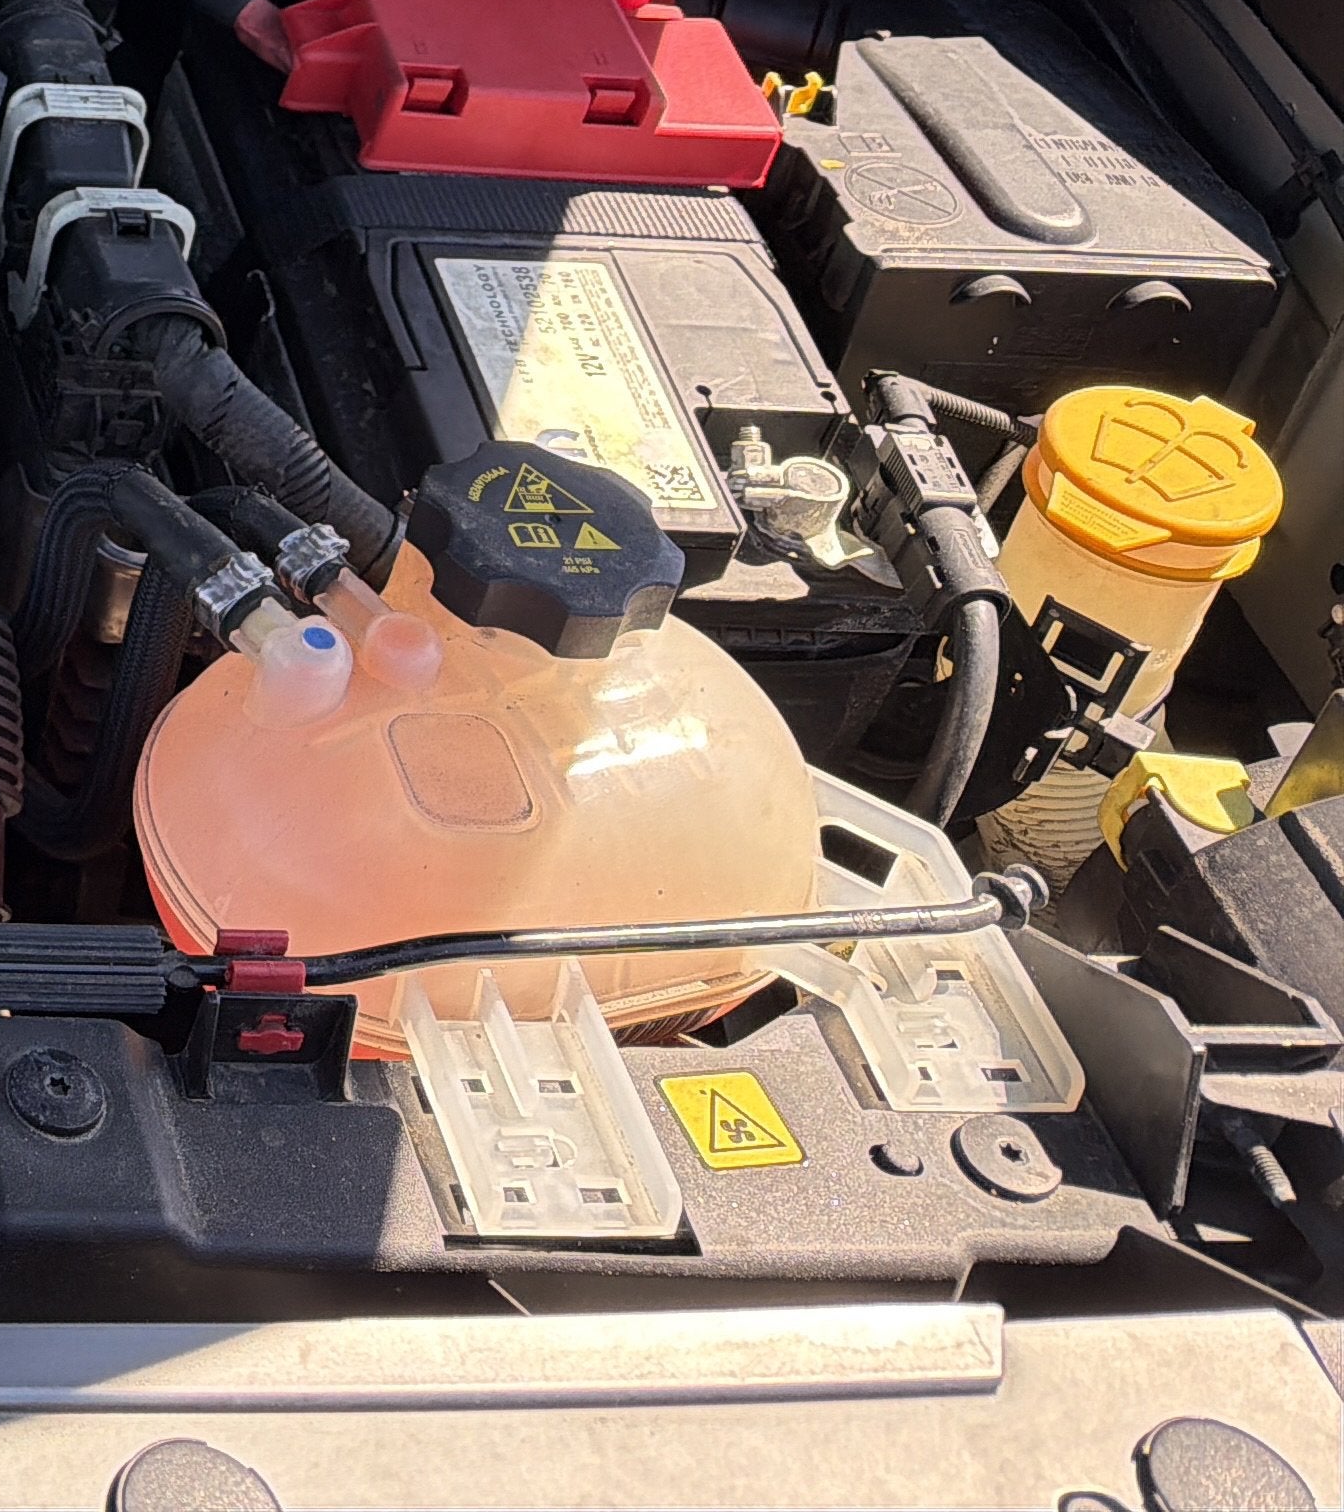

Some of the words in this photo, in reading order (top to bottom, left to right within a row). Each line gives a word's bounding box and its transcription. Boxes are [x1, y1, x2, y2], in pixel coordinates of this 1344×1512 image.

[473, 264, 521, 354] TECHNOLOGY
[512, 266, 557, 335] 52102538
[575, 353, 607, 377] 12V
